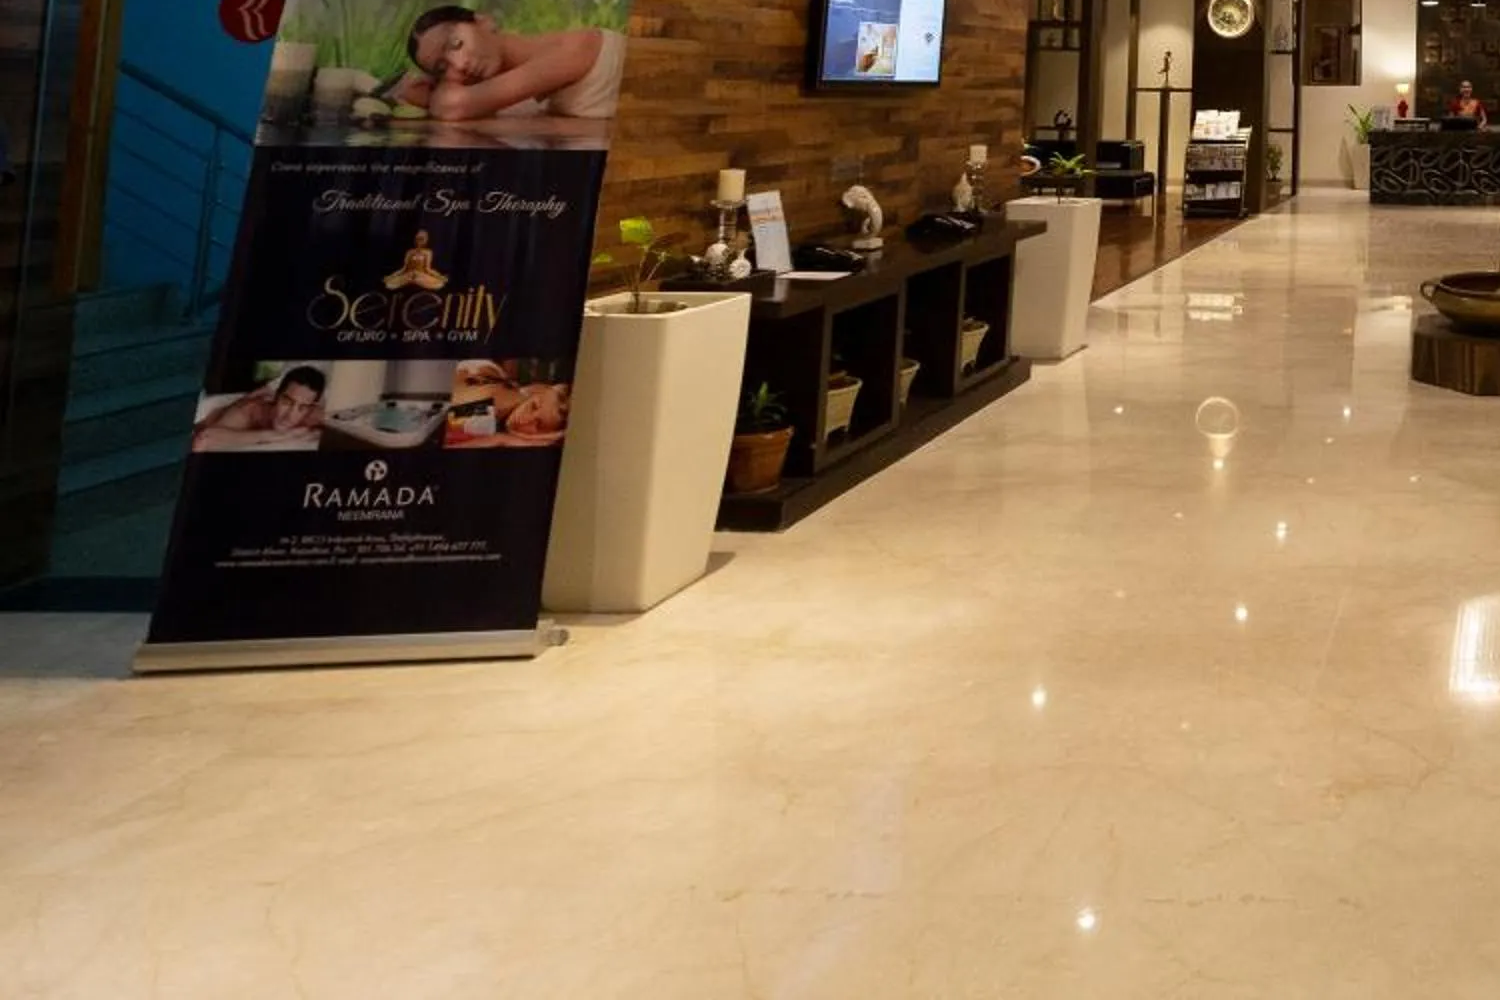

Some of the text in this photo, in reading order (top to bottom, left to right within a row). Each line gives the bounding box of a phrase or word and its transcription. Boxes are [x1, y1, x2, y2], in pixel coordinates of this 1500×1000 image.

[312, 189, 422, 214] Traditional
[422, 188, 471, 216] Spa
[306, 274, 508, 345] Serenity
[400, 328, 432, 343] SPA
[447, 328, 479, 342] GYM
[302, 482, 435, 508] RAMADA
